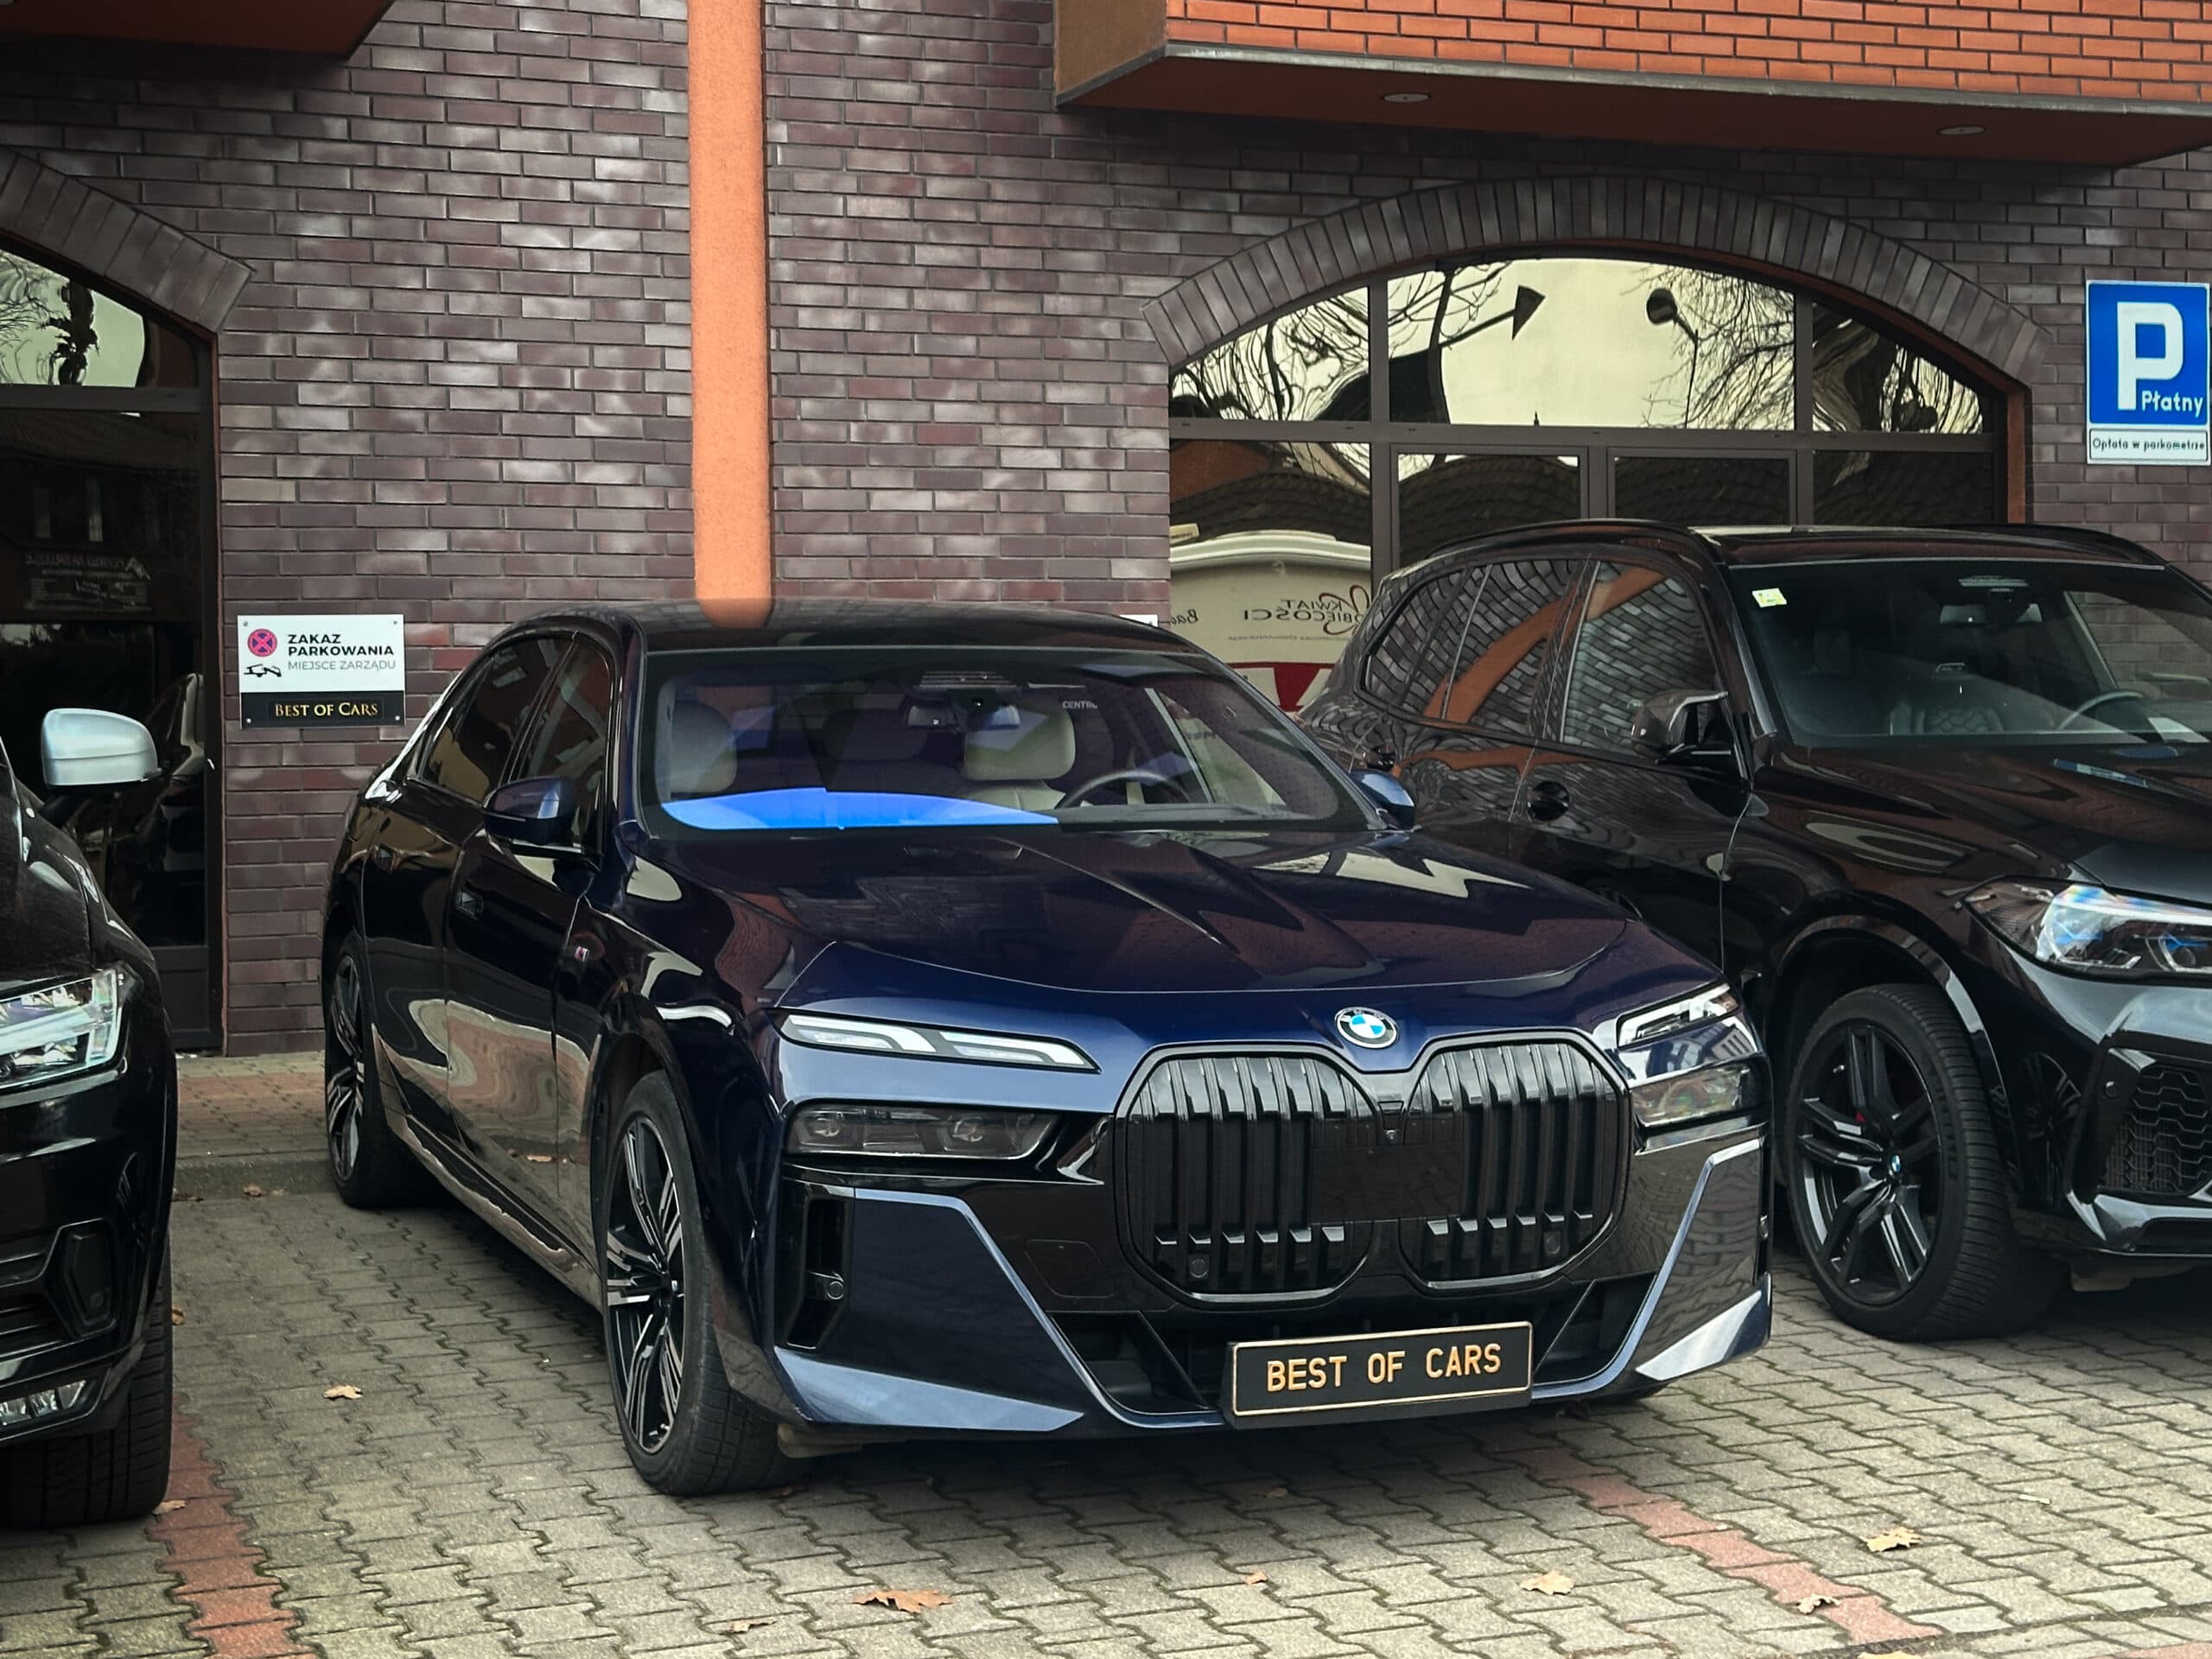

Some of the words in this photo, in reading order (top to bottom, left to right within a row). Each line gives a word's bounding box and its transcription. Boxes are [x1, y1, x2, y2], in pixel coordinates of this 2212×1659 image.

[2116, 301, 2183, 410] P
[2141, 390, 2203, 418] Płatny
[2132, 440, 2140, 449] w
[2143, 437, 2205, 453] parkometrze
[288, 633, 341, 645] ZAKAZ
[288, 645, 394, 657] PARKOWANIA
[288, 660, 336, 671] MIEJSCE
[340, 660, 396, 672] ZARZĄDU
[275, 702, 310, 717] BEST
[314, 703, 334, 716] OF
[338, 702, 378, 716] CARS
[1267, 1355, 1348, 1392] BEST
[1367, 1350, 1406, 1383] OF
[1426, 1343, 1502, 1378] CARS
